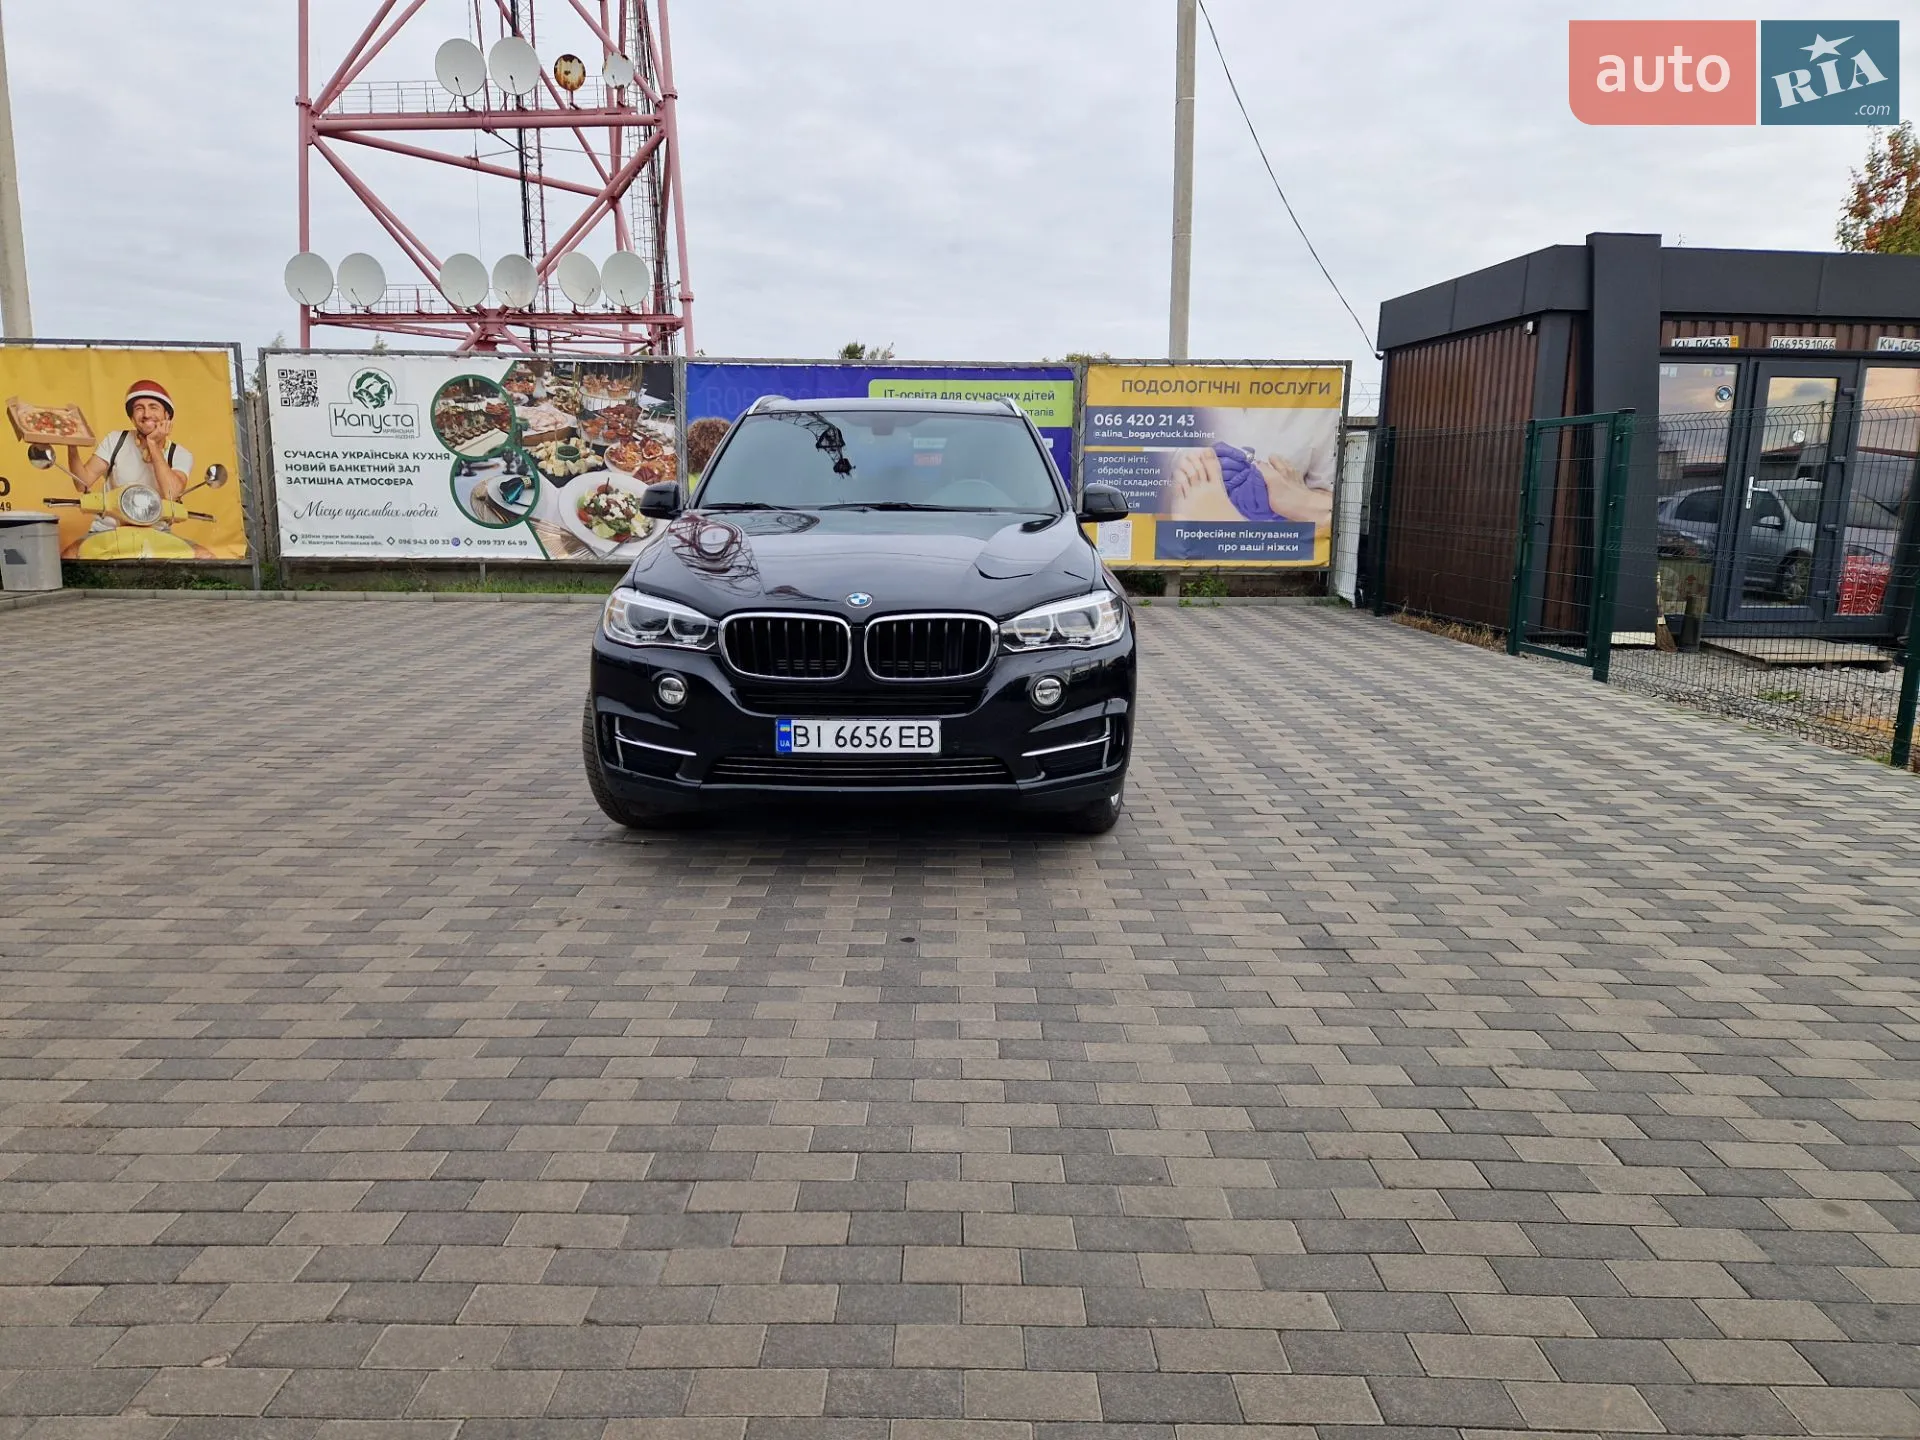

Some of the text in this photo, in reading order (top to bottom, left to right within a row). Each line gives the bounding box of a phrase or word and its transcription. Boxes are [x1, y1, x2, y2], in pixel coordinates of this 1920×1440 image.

[1772, 338, 1836, 349] 0669591066
[1121, 379, 1331, 395] ПОДОЛОГІЧНІ ПОСЛУГИ
[941, 391, 962, 401] для
[1023, 389, 1055, 402] дітей
[334, 408, 414, 433] Капуста
[1094, 414, 1195, 426] 066 420 21 43
[284, 450, 450, 460] СУЧАСНА УКРАЇНСЬКА КУХНЯ
[285, 463, 420, 473] НОВИЙ БАНКЕТНИЙ ЗАЛ
[1098, 466, 1134, 475] обробка
[287, 477, 413, 486] ЗАТИШНА АТМОСФЕРА
[294, 500, 342, 520] Місце
[345, 501, 400, 520] щасливих
[1176, 530, 1299, 540] Професійне піклування
[1218, 542, 1299, 552] про ваші ніжки
[793, 725, 935, 748] BI 6656 EB
